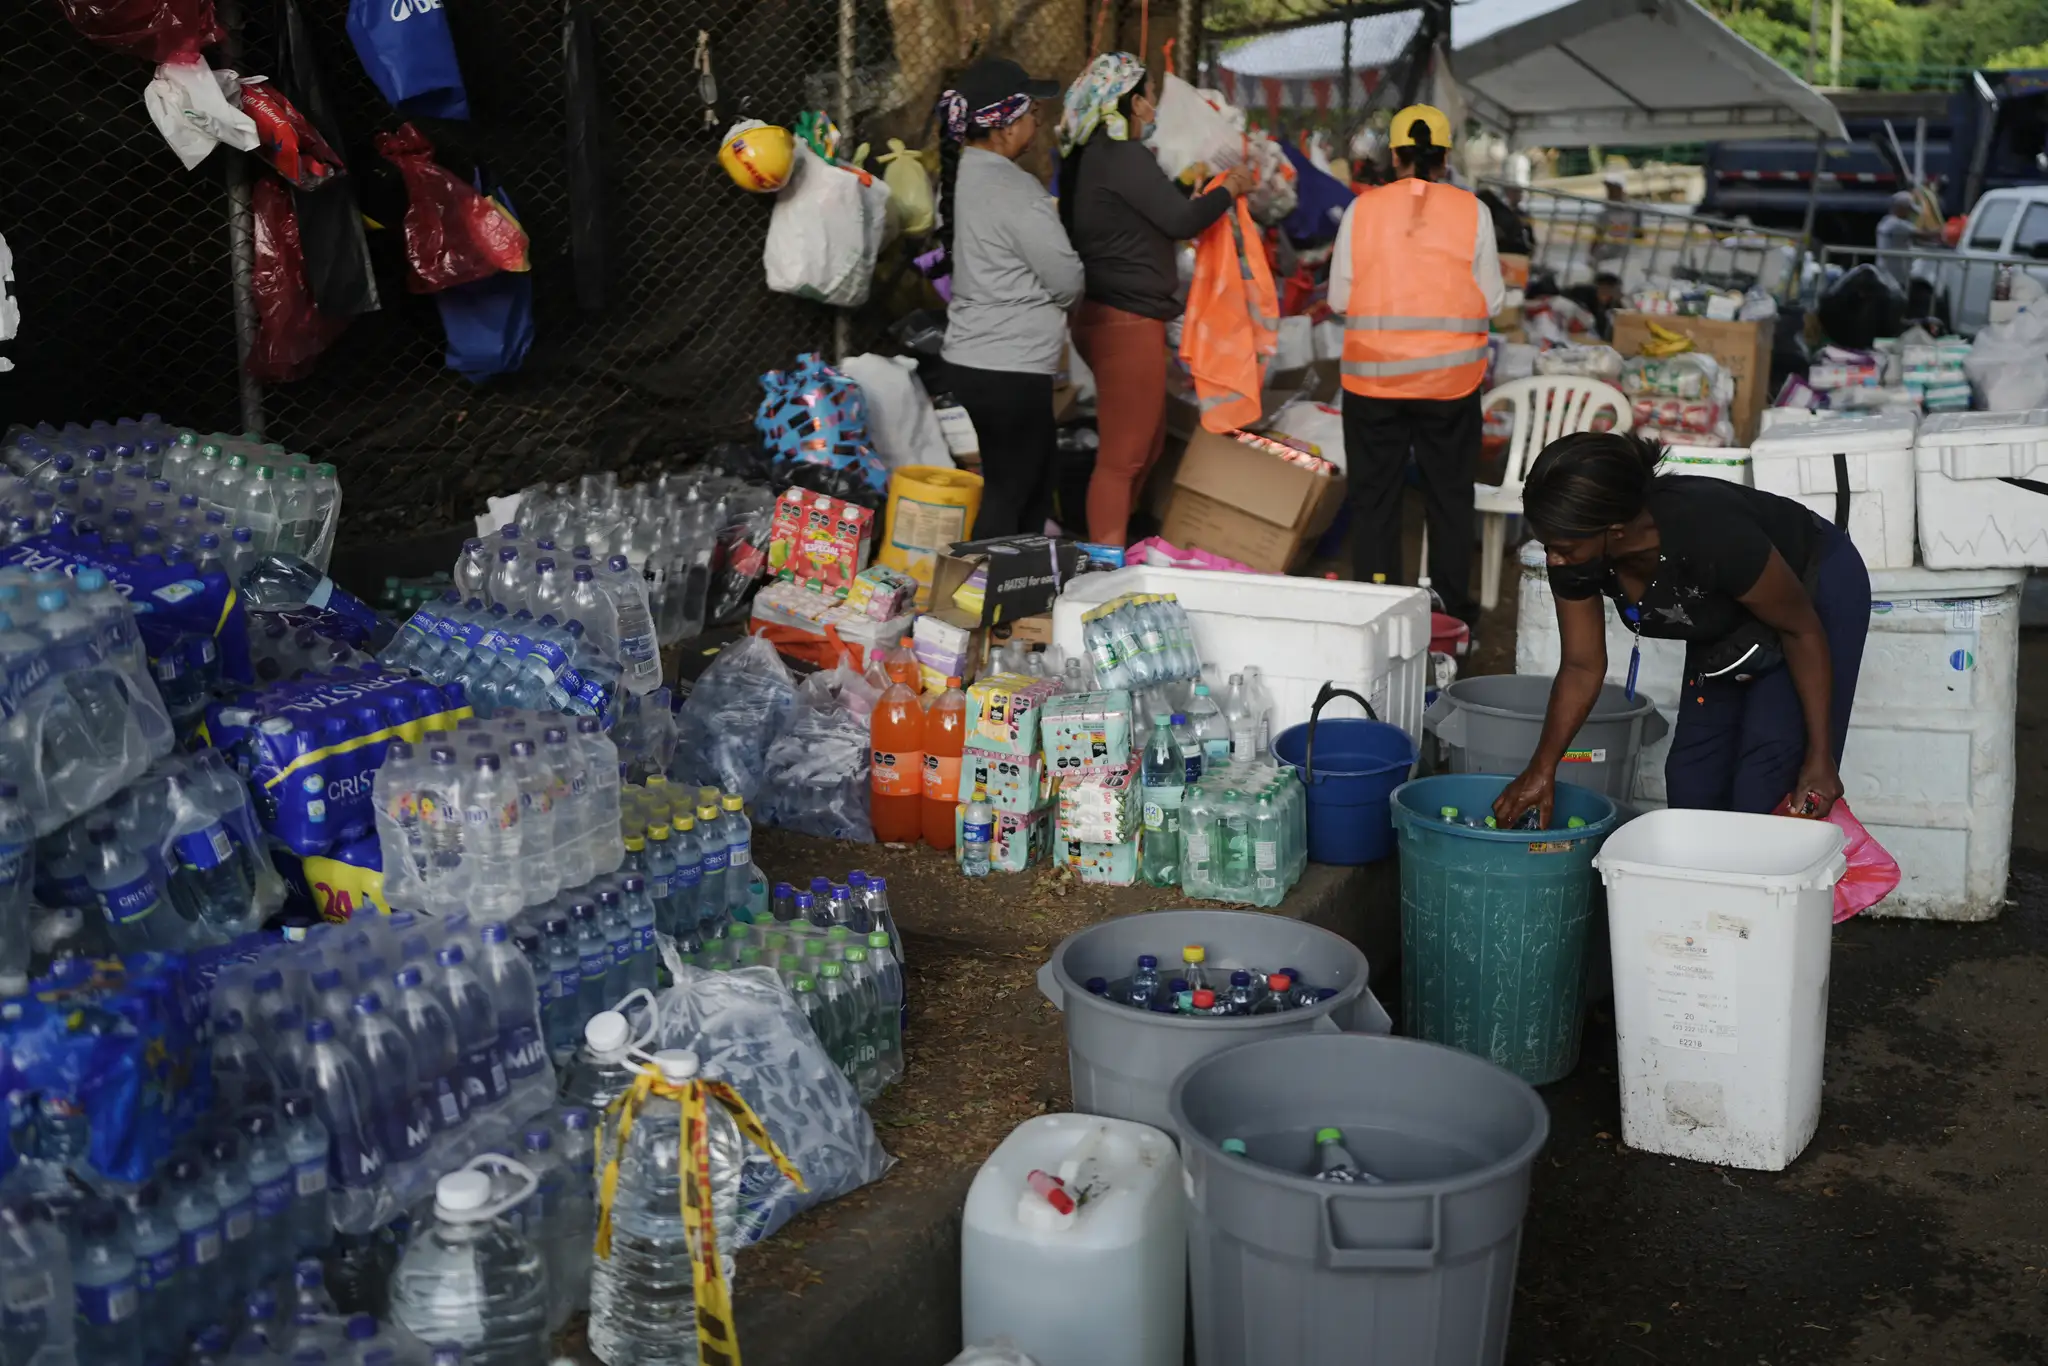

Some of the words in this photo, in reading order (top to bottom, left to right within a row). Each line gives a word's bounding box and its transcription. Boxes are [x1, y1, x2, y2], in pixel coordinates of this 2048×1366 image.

[1003, 575, 1028, 592] HATSU
[279, 674, 407, 712] CRISTAL
[314, 881, 354, 919] 24
